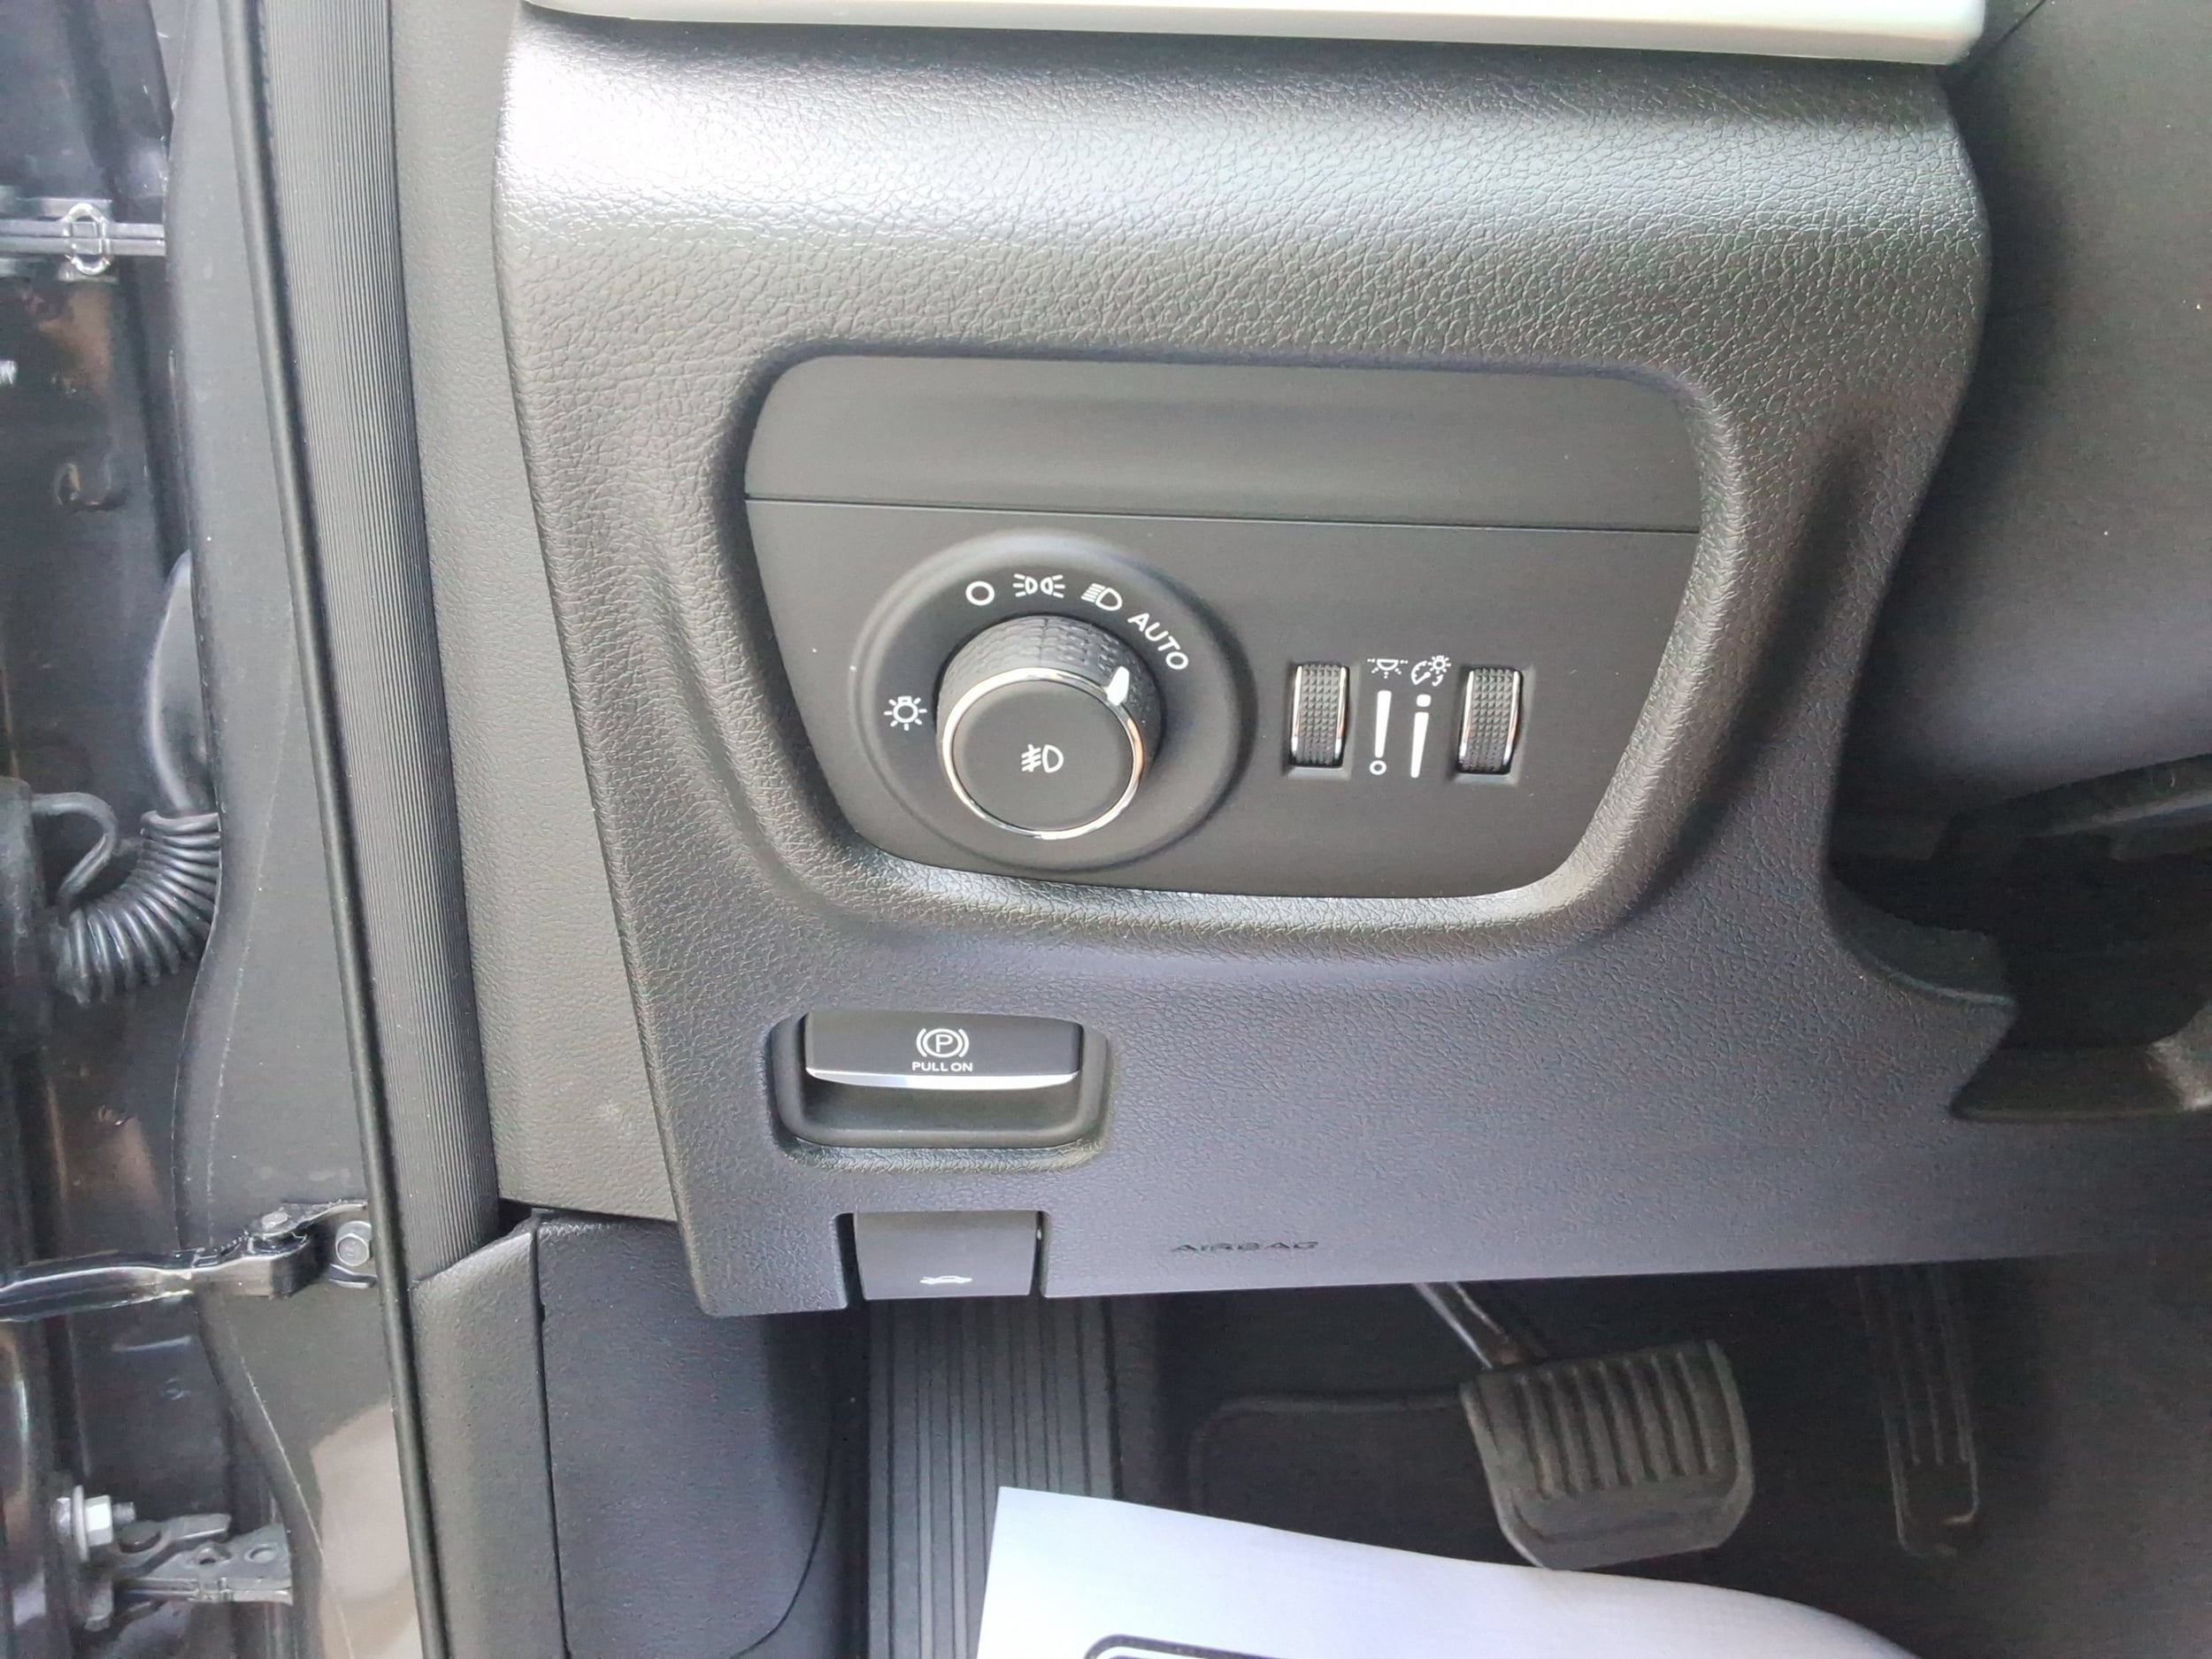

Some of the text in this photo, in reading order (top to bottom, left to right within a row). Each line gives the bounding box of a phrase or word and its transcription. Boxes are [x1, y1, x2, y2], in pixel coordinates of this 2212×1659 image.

[1127, 612, 1189, 670] AUTO
[935, 1033, 954, 1053] P
[911, 1061, 973, 1072] PULL ON
[1171, 1240, 1319, 1252] AIRBAG
